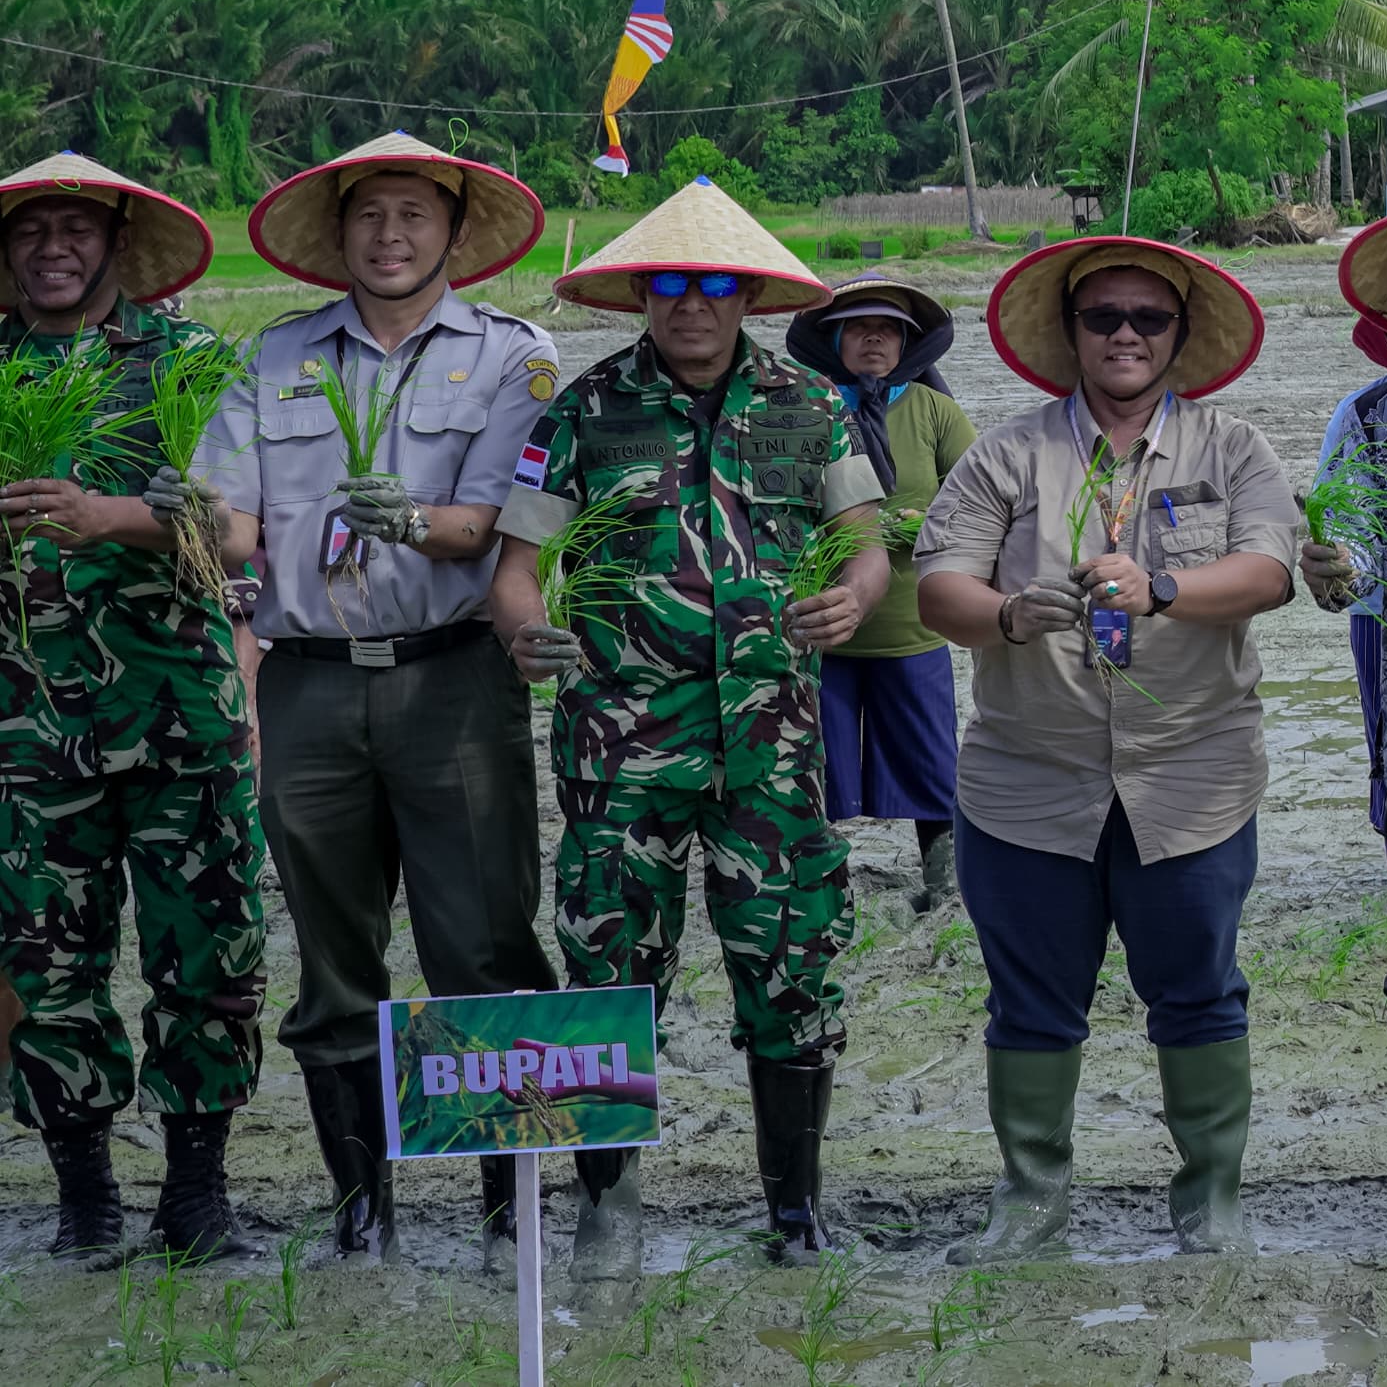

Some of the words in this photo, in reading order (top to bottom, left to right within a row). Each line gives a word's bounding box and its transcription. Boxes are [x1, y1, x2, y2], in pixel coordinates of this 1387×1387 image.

[752, 438, 788, 454] TNI
[801, 438, 825, 455] AD
[421, 1042, 629, 1096] BUPATI
